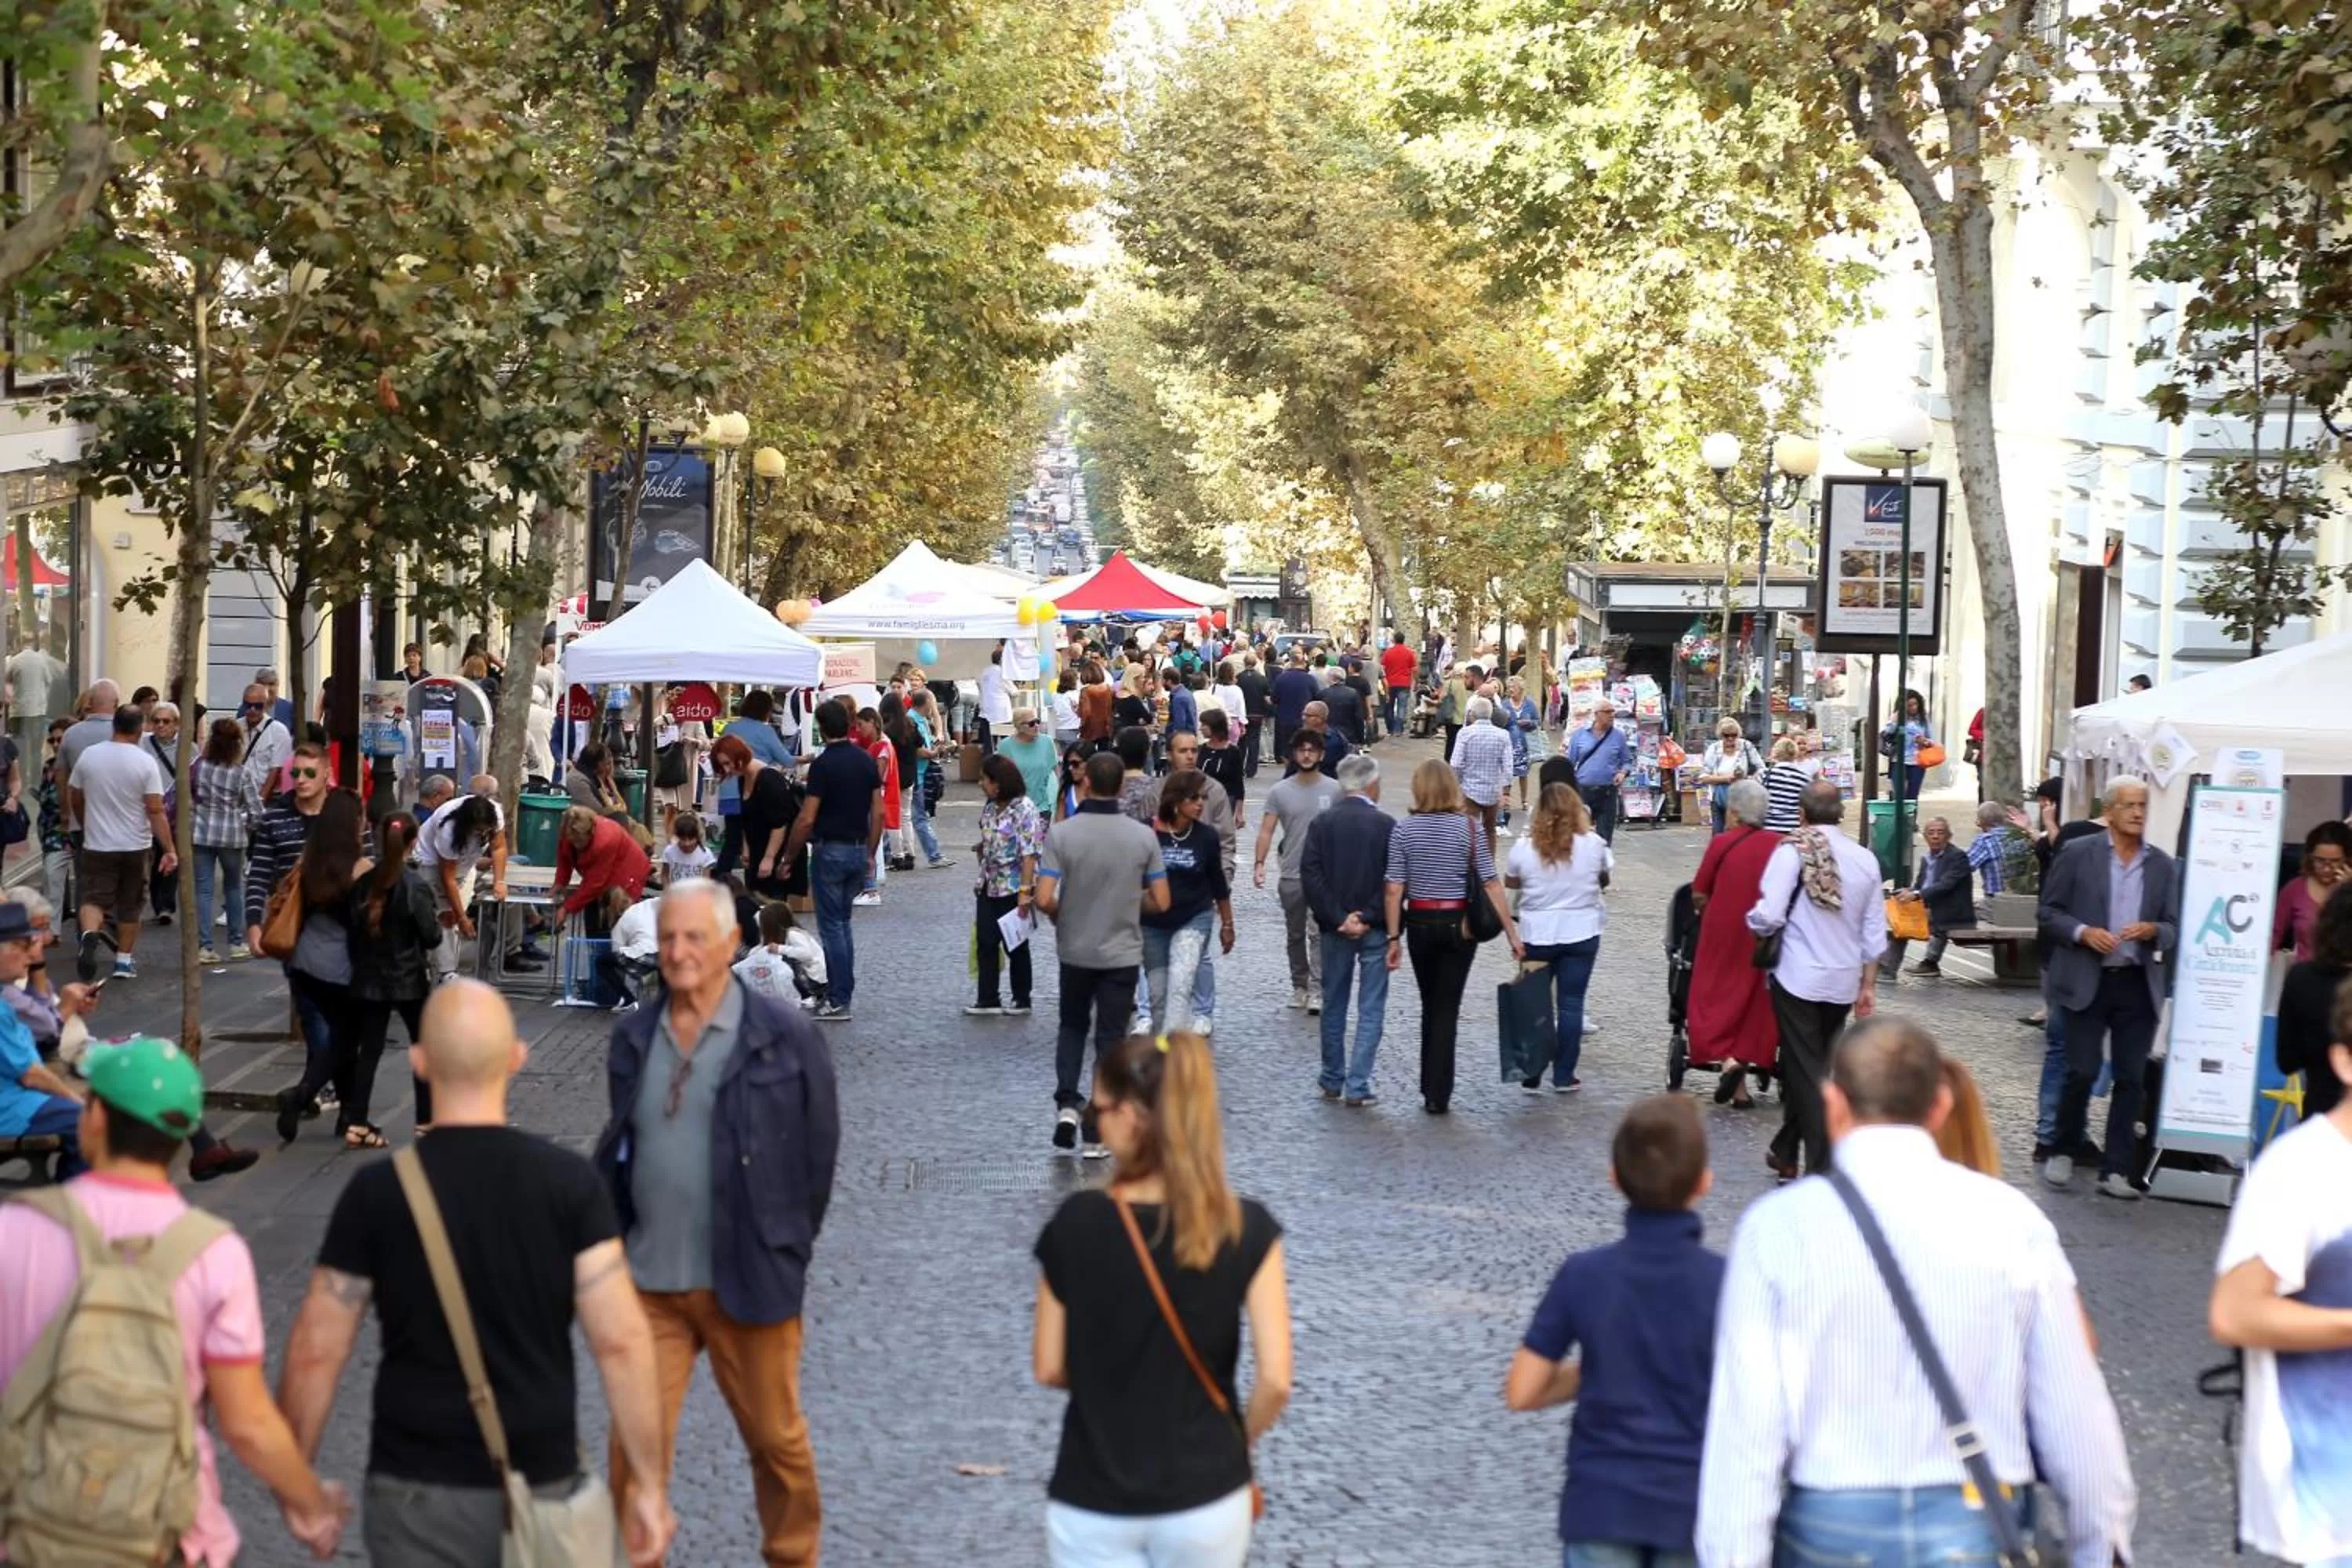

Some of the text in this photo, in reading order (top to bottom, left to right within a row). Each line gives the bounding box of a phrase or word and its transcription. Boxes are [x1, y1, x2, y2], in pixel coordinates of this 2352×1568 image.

[641, 474, 687, 499] Nobili
[574, 619, 607, 631] VOM
[557, 702, 591, 717] ado
[677, 702, 712, 718] aido
